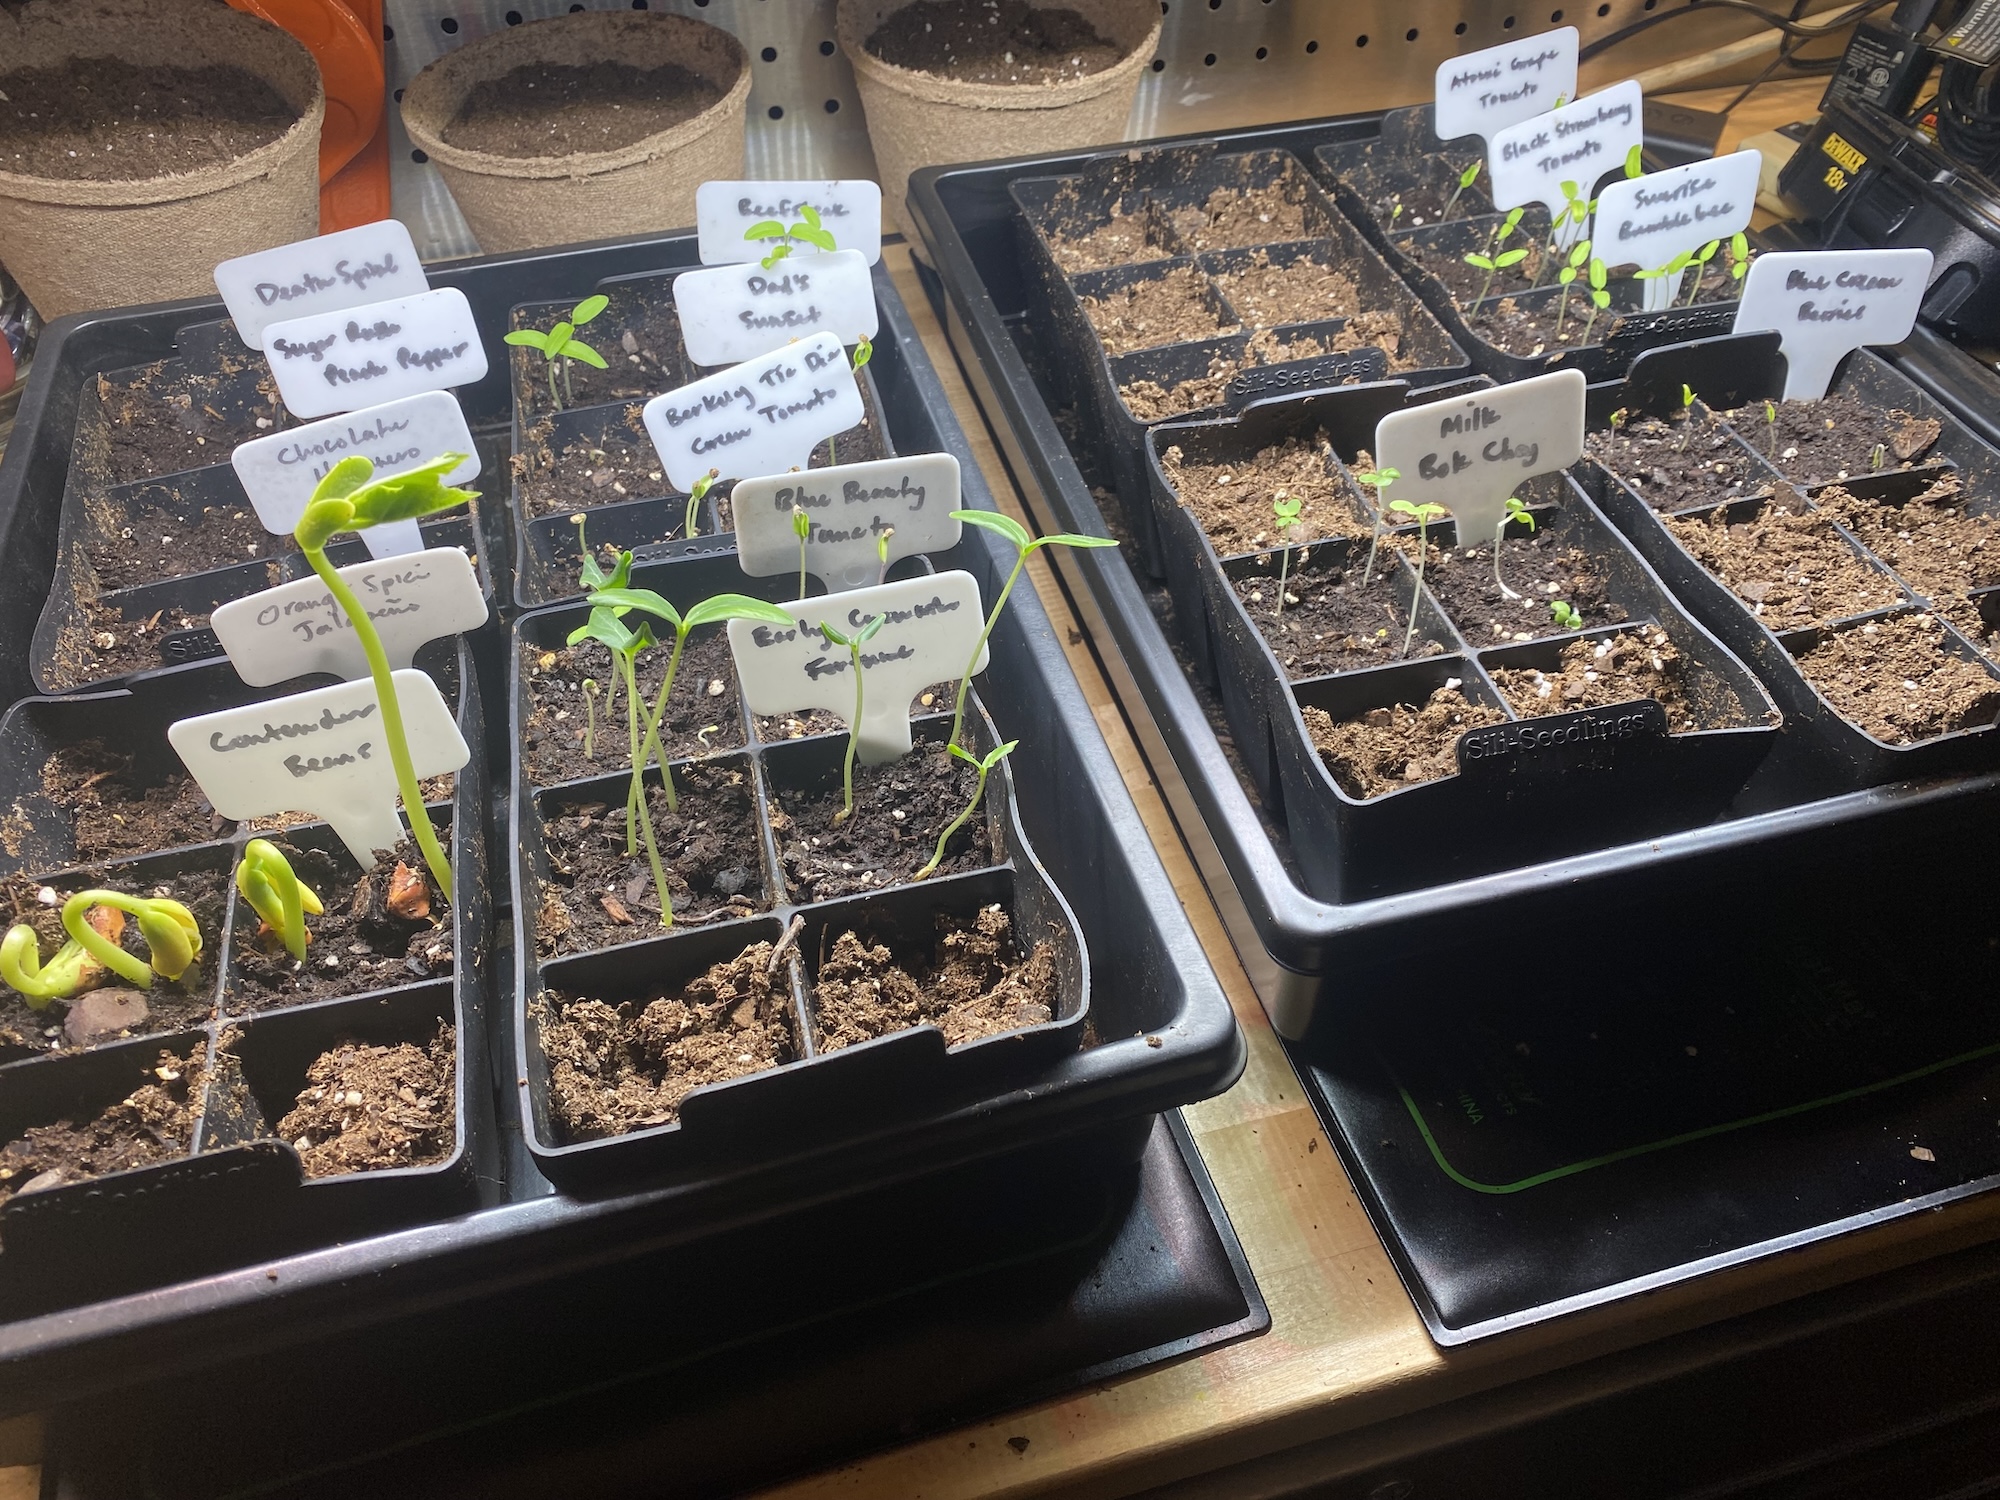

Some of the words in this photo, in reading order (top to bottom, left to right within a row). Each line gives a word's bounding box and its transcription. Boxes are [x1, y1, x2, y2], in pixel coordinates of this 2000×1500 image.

[1952, 0, 1996, 38] Warnin
[1479, 82, 1538, 109] Tomato
[1502, 132, 1550, 161] Black
[1537, 140, 1602, 173] Tomato
[747, 274, 810, 296] Dad's
[738, 305, 822, 330] Sunset
[758, 388, 837, 424] Tomato
[1441, 401, 1501, 438] Milk
[1419, 451, 1474, 480] Bok
[1482, 437, 1539, 467] Choy
[257, 584, 346, 626] Orang
[283, 742, 372, 778] Beans
